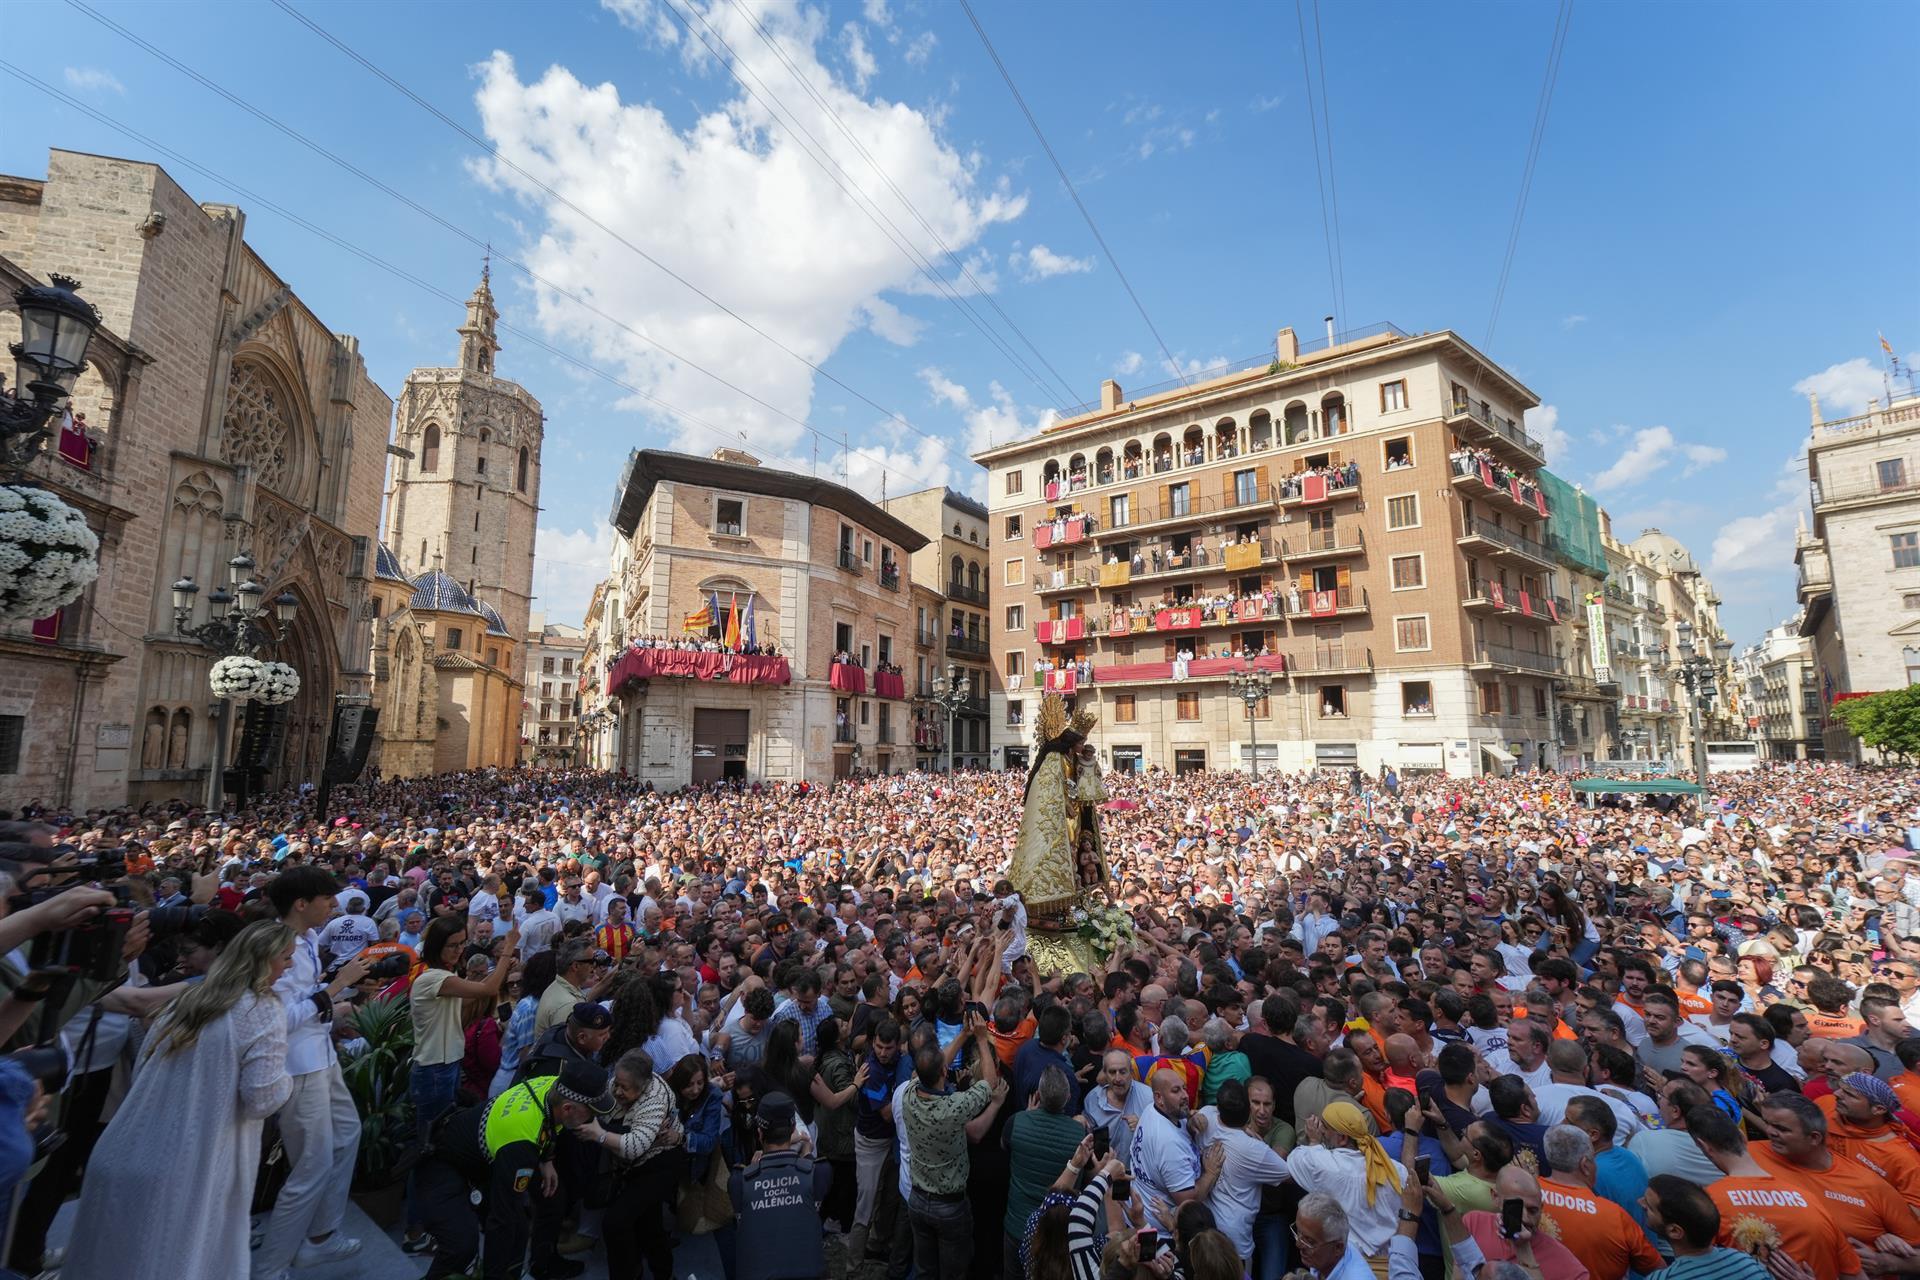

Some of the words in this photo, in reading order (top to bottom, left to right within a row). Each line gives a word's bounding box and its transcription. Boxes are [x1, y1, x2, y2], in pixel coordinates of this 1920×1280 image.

[754, 1175, 800, 1190] POLICIA
[764, 1187, 790, 1198] LOCAL
[1540, 1188, 1597, 1215] XIDORS
[1727, 1189, 1808, 1208] EIXIDORS
[1824, 1190, 1866, 1208] EIXIDORS
